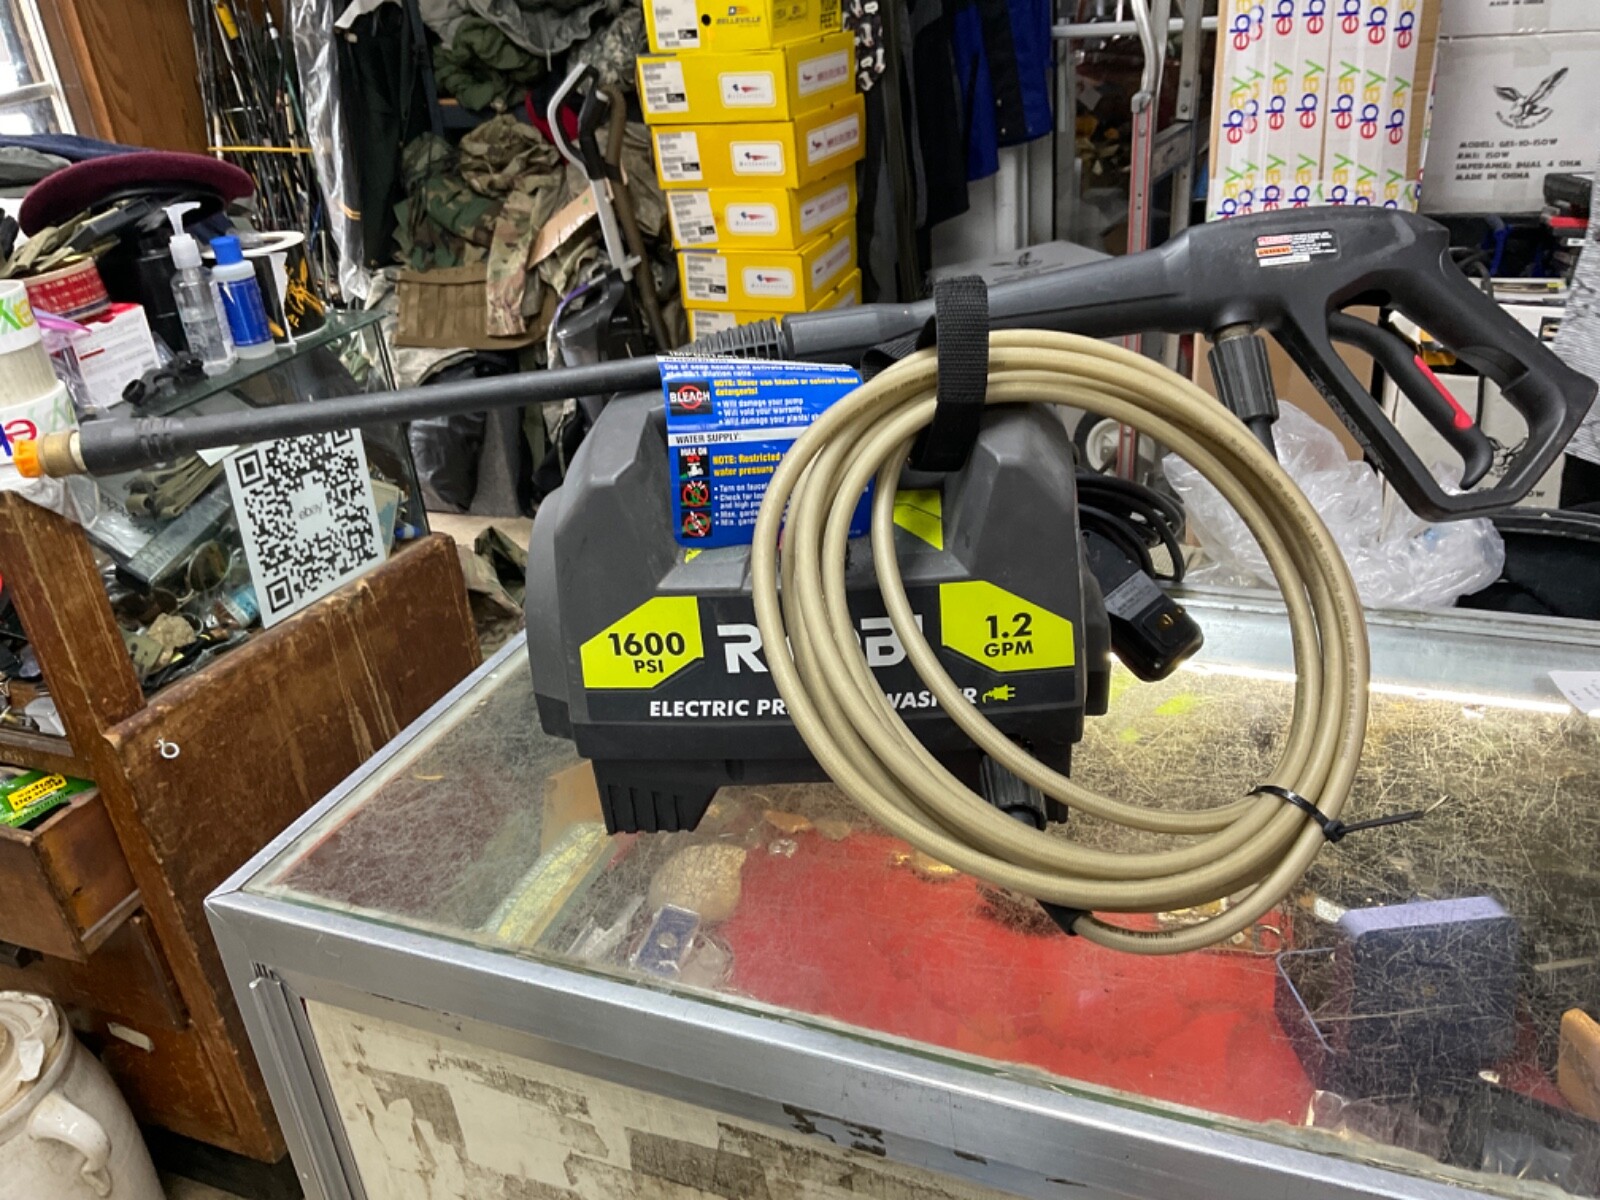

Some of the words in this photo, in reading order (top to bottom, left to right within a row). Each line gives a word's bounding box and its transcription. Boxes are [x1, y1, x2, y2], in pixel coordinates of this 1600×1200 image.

[1229, 0, 1252, 51] eba
[1271, 0, 1294, 36] eb
[1302, 0, 1325, 35] eb
[1337, 0, 1360, 35] eb
[1393, 0, 1415, 49] eba
[1265, 62, 1293, 130] ebay
[1295, 59, 1325, 129] ebay
[1331, 61, 1360, 130] ebay
[1357, 69, 1386, 140] ebay
[1223, 76, 1251, 144] ebay
[1385, 76, 1411, 145] ebay
[1325, 153, 1354, 206] bay
[1216, 166, 1243, 219] bay
[714, 379, 735, 387] NOTE:
[669, 391, 710, 402] BLEACH
[722, 400, 737, 408] Will
[739, 399, 766, 408] damage
[768, 399, 783, 407] your
[784, 398, 803, 406] pump
[724, 408, 738, 416] Will
[740, 408, 754, 416] void
[756, 408, 771, 416] your
[773, 406, 802, 415] warranty
[725, 418, 739, 426] Will
[741, 417, 768, 426] damage
[770, 416, 785, 424] your
[676, 435, 705, 444] WATER
[707, 433, 741, 442] SUPPLY:
[713, 456, 737, 465] NOTE:
[738, 453, 780, 463] Restricted
[714, 468, 736, 477] water
[739, 466, 773, 477] pressure
[720, 494, 740, 502] Check
[735, 501, 749, 509] high
[739, 509, 758, 518] garde
[985, 612, 1032, 639] 1.2
[608, 632, 685, 656] 1600
[984, 640, 1033, 658] GPM
[634, 660, 664, 674] PSI
[649, 699, 750, 717] ELECTRIC
[885, 687, 978, 709] WASR
